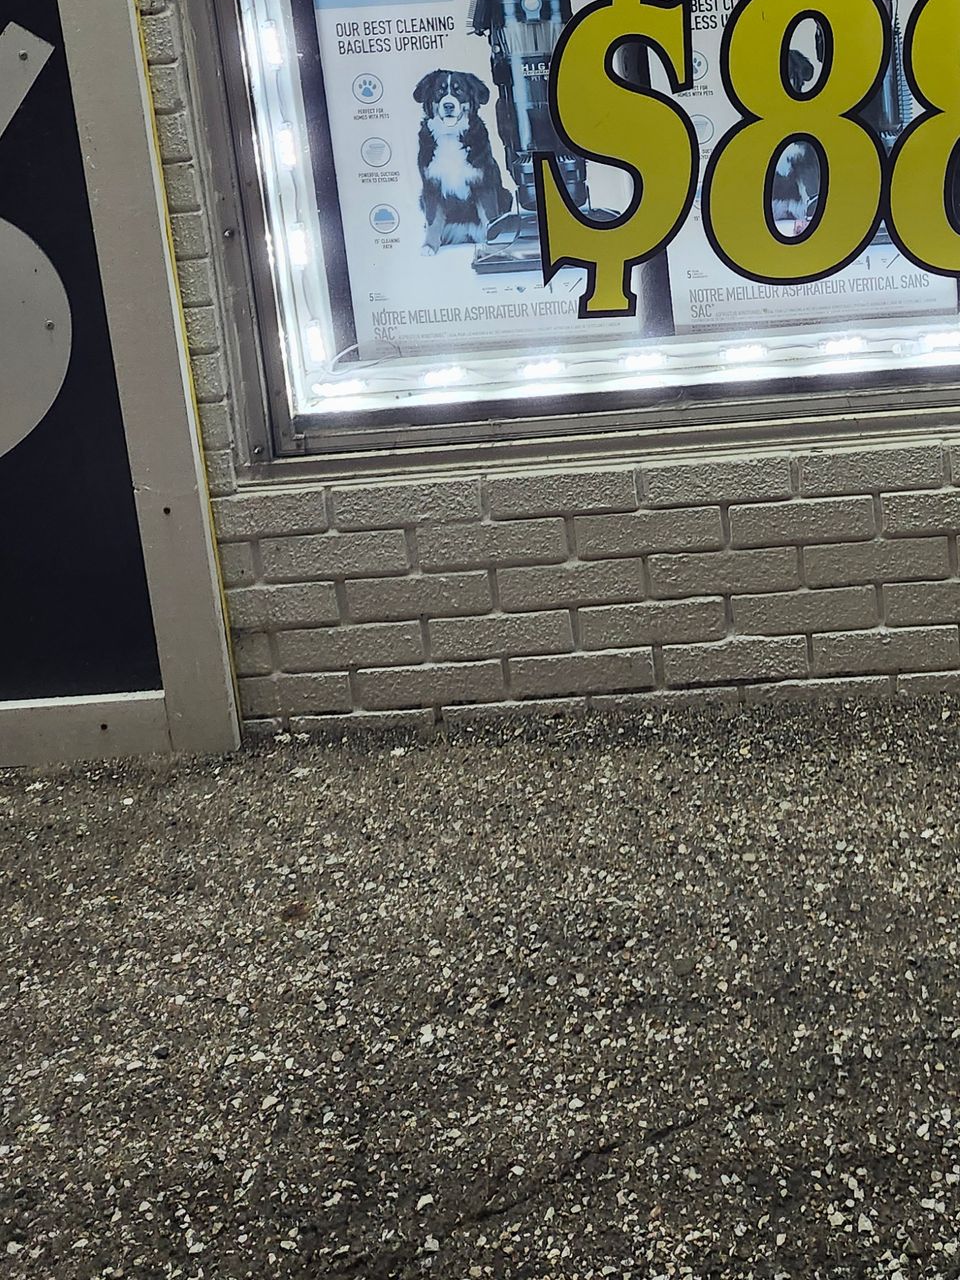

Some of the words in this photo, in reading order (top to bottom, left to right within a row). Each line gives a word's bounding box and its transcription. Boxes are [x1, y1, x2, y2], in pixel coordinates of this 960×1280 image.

[336, 22, 360, 37] OUR
[363, 19, 392, 36] BEST
[396, 16, 455, 33] CLEANING
[338, 38, 391, 55] BAGLESS
[687, 270, 692, 279] 5
[369, 292, 374, 301] 5
[689, 288, 724, 303] NOTRE
[726, 285, 780, 302] MEILLEUR
[782, 279, 846, 297] ASPIRATEUR
[848, 276, 898, 292] VERTICAL
[901, 273, 930, 289] SANS
[372, 309, 407, 326] NOTRE
[408, 307, 462, 324] MEILLEUR
[464, 303, 528, 321] ASPIRATEUR
